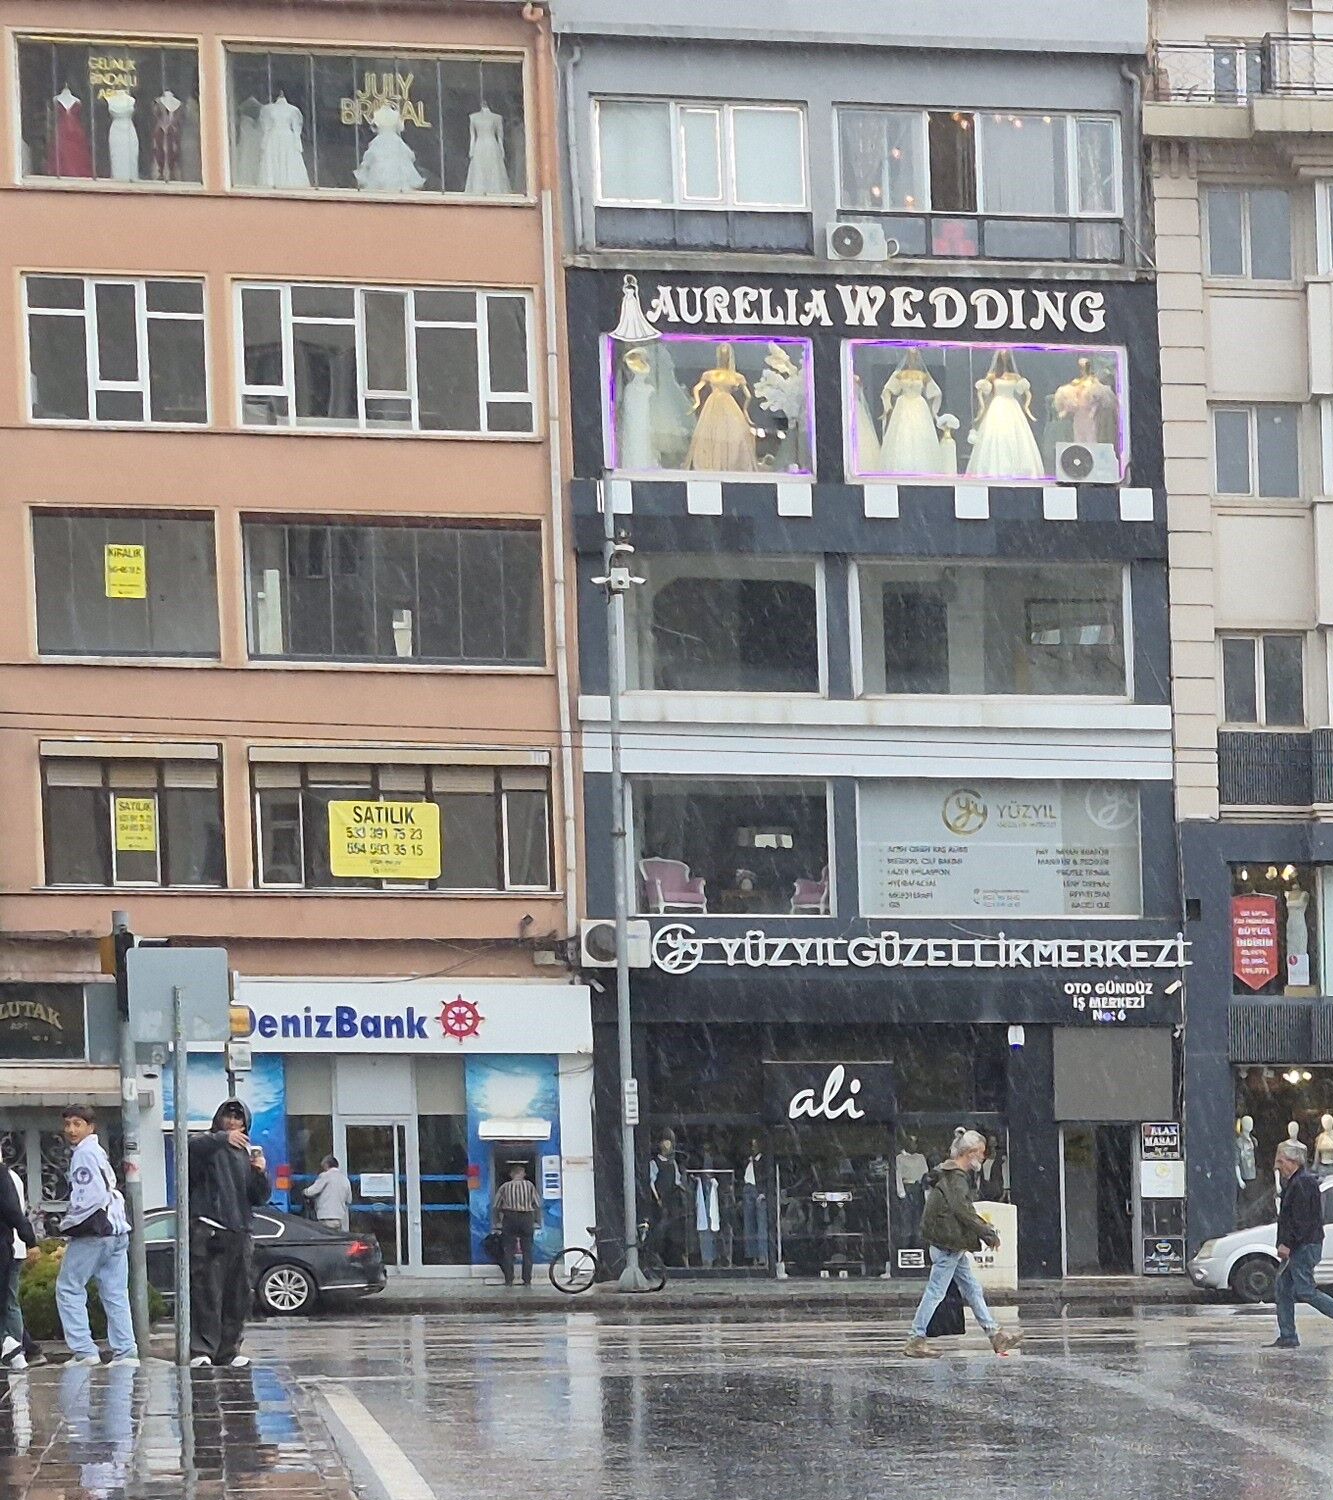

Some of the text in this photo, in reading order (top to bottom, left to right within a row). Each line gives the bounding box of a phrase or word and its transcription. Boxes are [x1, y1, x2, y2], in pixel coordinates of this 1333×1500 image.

[356, 72, 414, 100] JULY
[646, 284, 1107, 333] AURELIA WEDDING
[353, 805, 415, 825] SATILIK
[997, 800, 1056, 819] YÜZYIL
[411, 845, 424, 856] 15
[1064, 980, 1153, 995] OTO GÜNDÜZ
[1073, 995, 1086, 1011] İŞ
[248, 1006, 428, 1039] enizBank
[788, 1064, 865, 1120] ali
